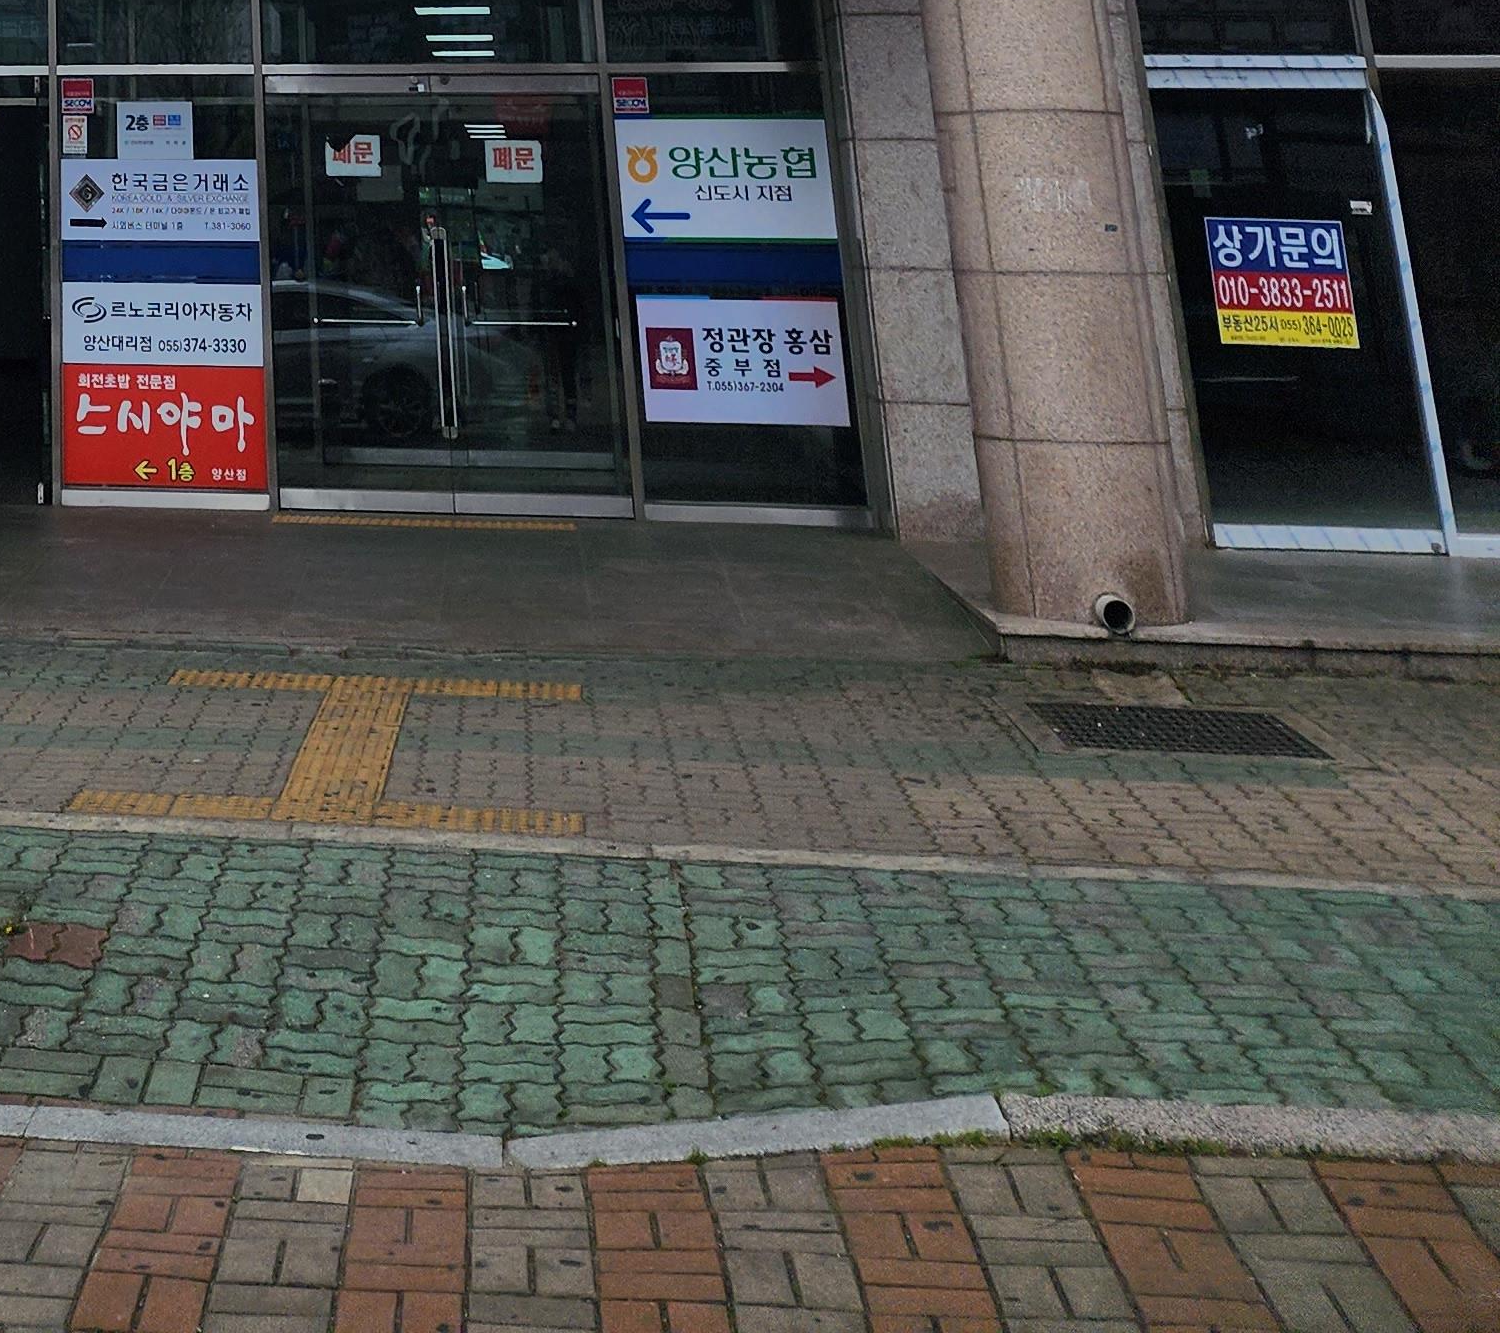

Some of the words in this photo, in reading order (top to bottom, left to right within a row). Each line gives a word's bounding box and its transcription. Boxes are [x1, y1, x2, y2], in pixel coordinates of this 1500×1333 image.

[64, 99, 92, 107] SECOM
[616, 99, 647, 107] SECOM
[125, 115, 150, 131] 2층
[492, 147, 534, 170] 폐문
[668, 146, 817, 180] 양산농협
[111, 173, 249, 193] 한국금은거래소
[694, 185, 749, 201] 신도시
[757, 185, 792, 202] 지점
[1212, 224, 1343, 269] 상가문의
[1217, 275, 1350, 309] 010-3833-2511
[110, 301, 253, 322] 르노코리아자동차
[83, 335, 151, 352] 양산대리점
[158, 338, 247, 353] 055)374-3330
[702, 328, 776, 353] 정관장
[783, 328, 833, 355] 홍삼
[77, 373, 130, 389] 회전초밥
[136, 374, 175, 390] 전문점
[76, 391, 256, 457] 스시야마
[167, 458, 195, 482] 1층
[211, 468, 247, 482] 양산점
